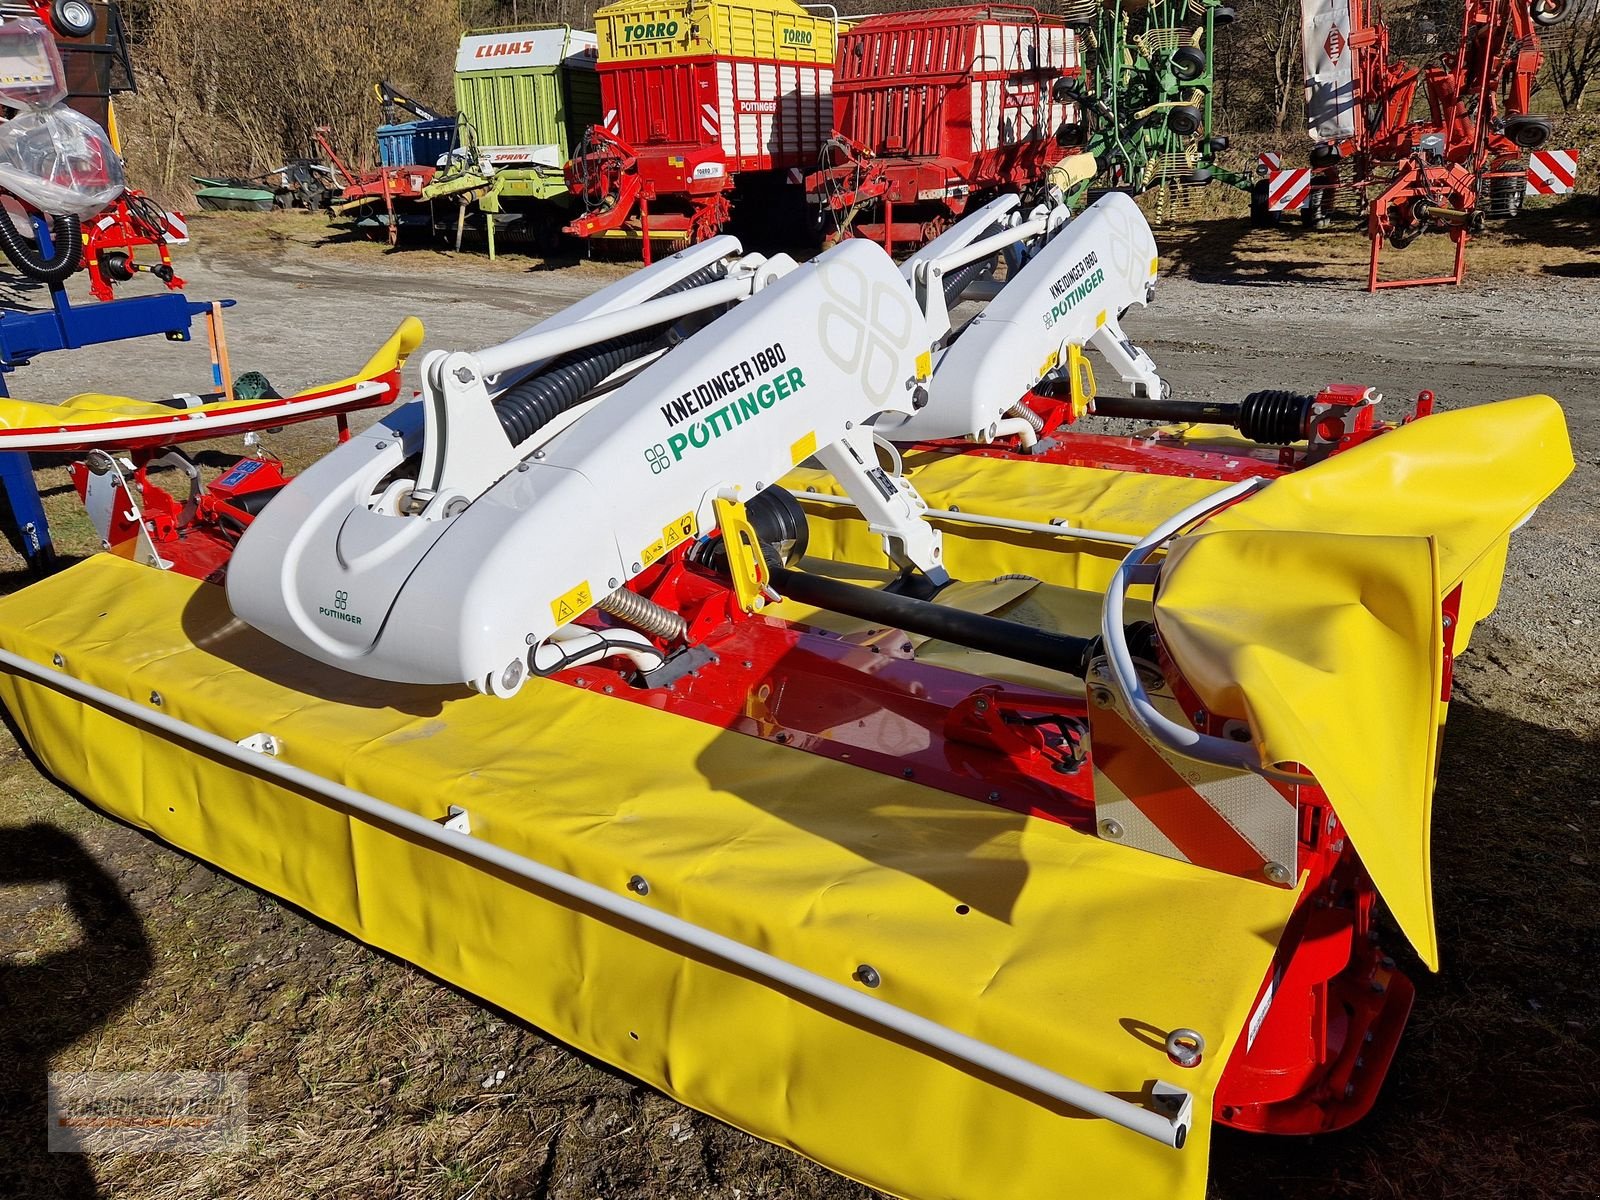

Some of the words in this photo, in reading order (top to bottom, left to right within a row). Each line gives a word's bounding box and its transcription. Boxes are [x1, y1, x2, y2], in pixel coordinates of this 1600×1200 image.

[624, 21, 678, 42] TORRO
[783, 28, 812, 44] TORRO
[475, 41, 534, 58] CLAAS
[494, 153, 531, 161] SPRINT
[1049, 261, 1086, 300] KNEIDINGER
[1083, 250, 1098, 270] 1880
[660, 360, 755, 427] KNEIDINGER
[751, 342, 787, 377] 1880
